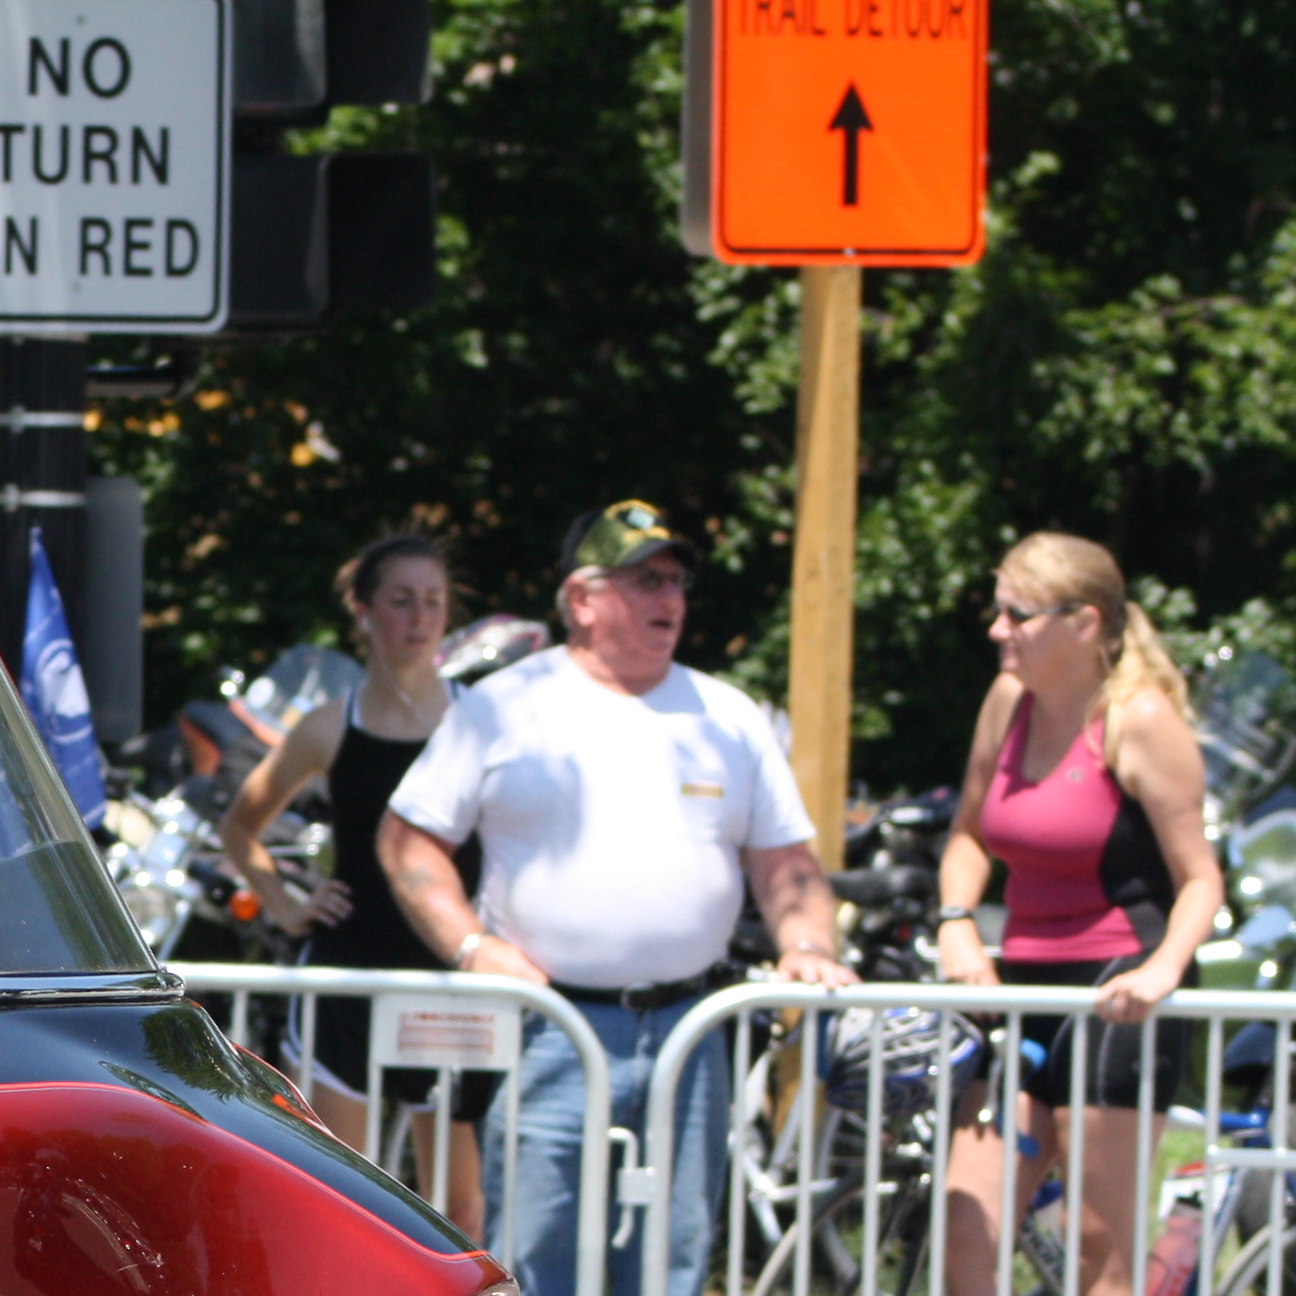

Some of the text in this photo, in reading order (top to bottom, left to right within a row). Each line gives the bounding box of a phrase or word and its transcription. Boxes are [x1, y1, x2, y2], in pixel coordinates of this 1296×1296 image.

[846, 0, 967, 38] DETOUR
[28, 37, 131, 98] NO
[80, 217, 200, 278] RED
